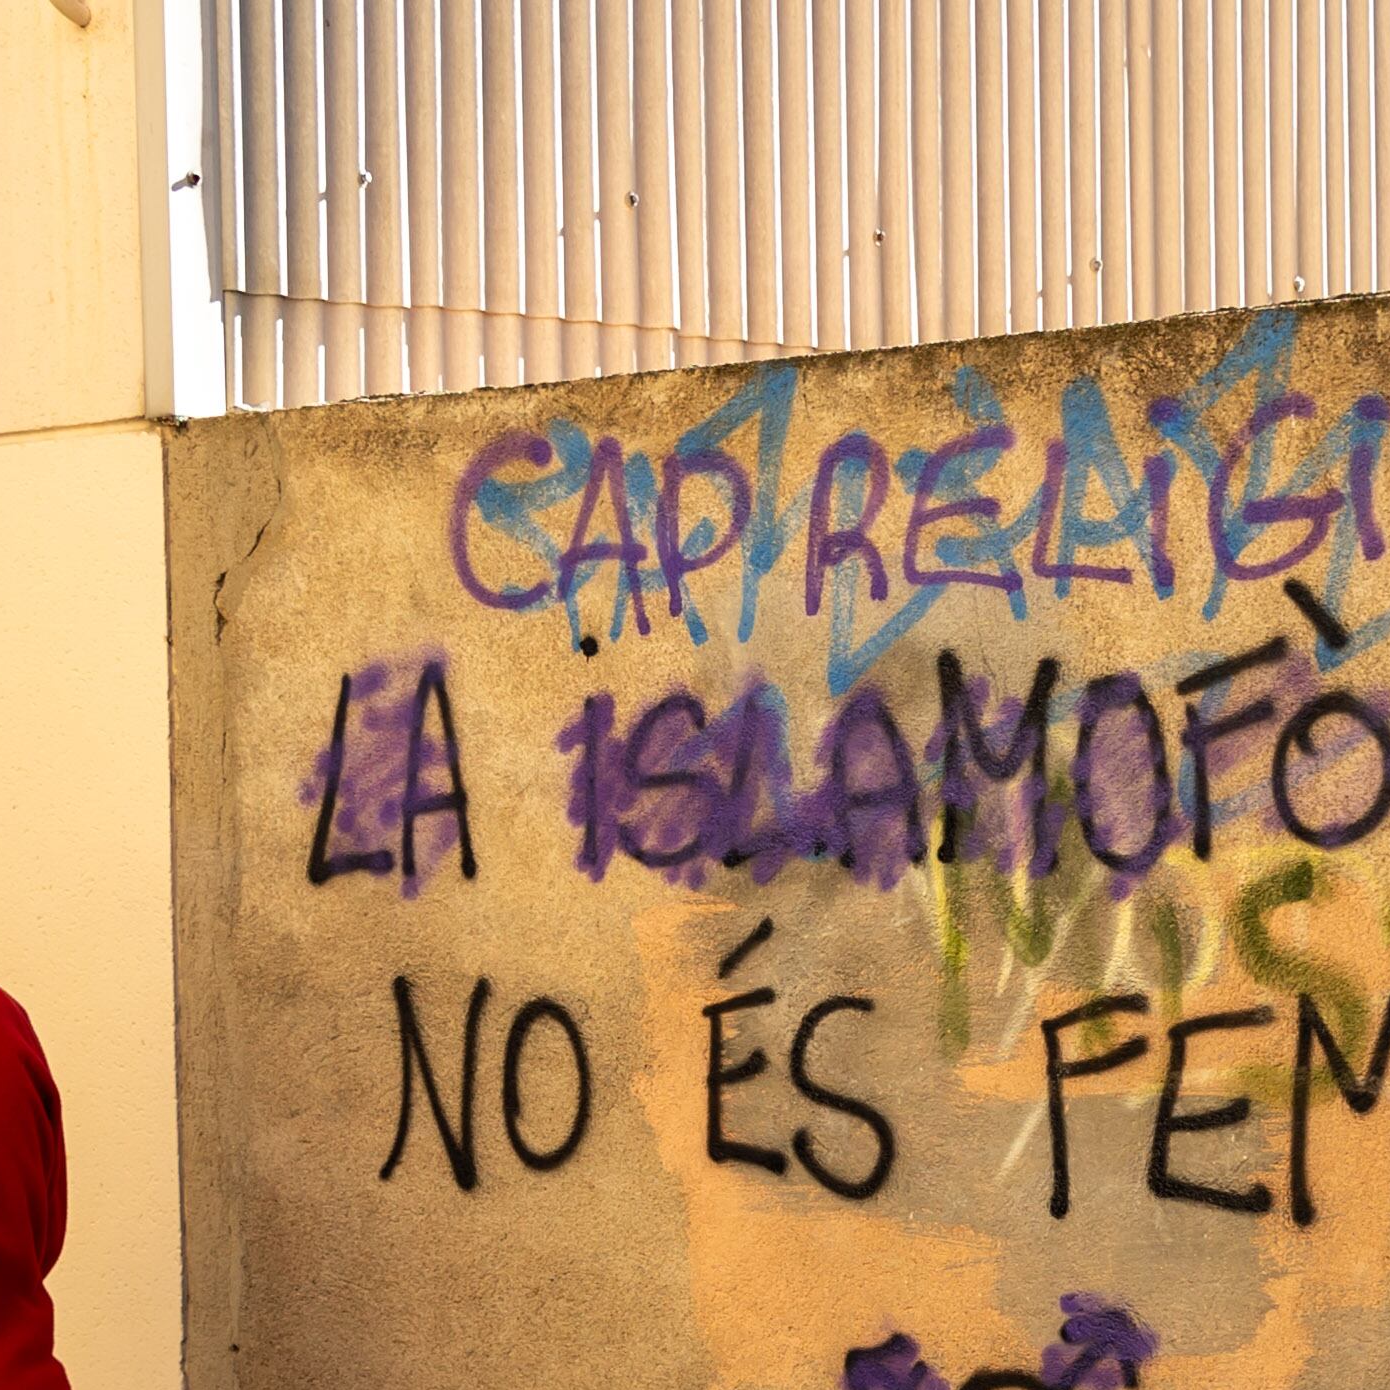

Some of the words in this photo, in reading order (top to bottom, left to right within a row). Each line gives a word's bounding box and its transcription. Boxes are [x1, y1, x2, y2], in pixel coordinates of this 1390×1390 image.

[448, 436, 752, 636] CAP
[308, 660, 479, 886] LA
[377, 974, 592, 1193] NO
[702, 915, 897, 1199] ÉS
